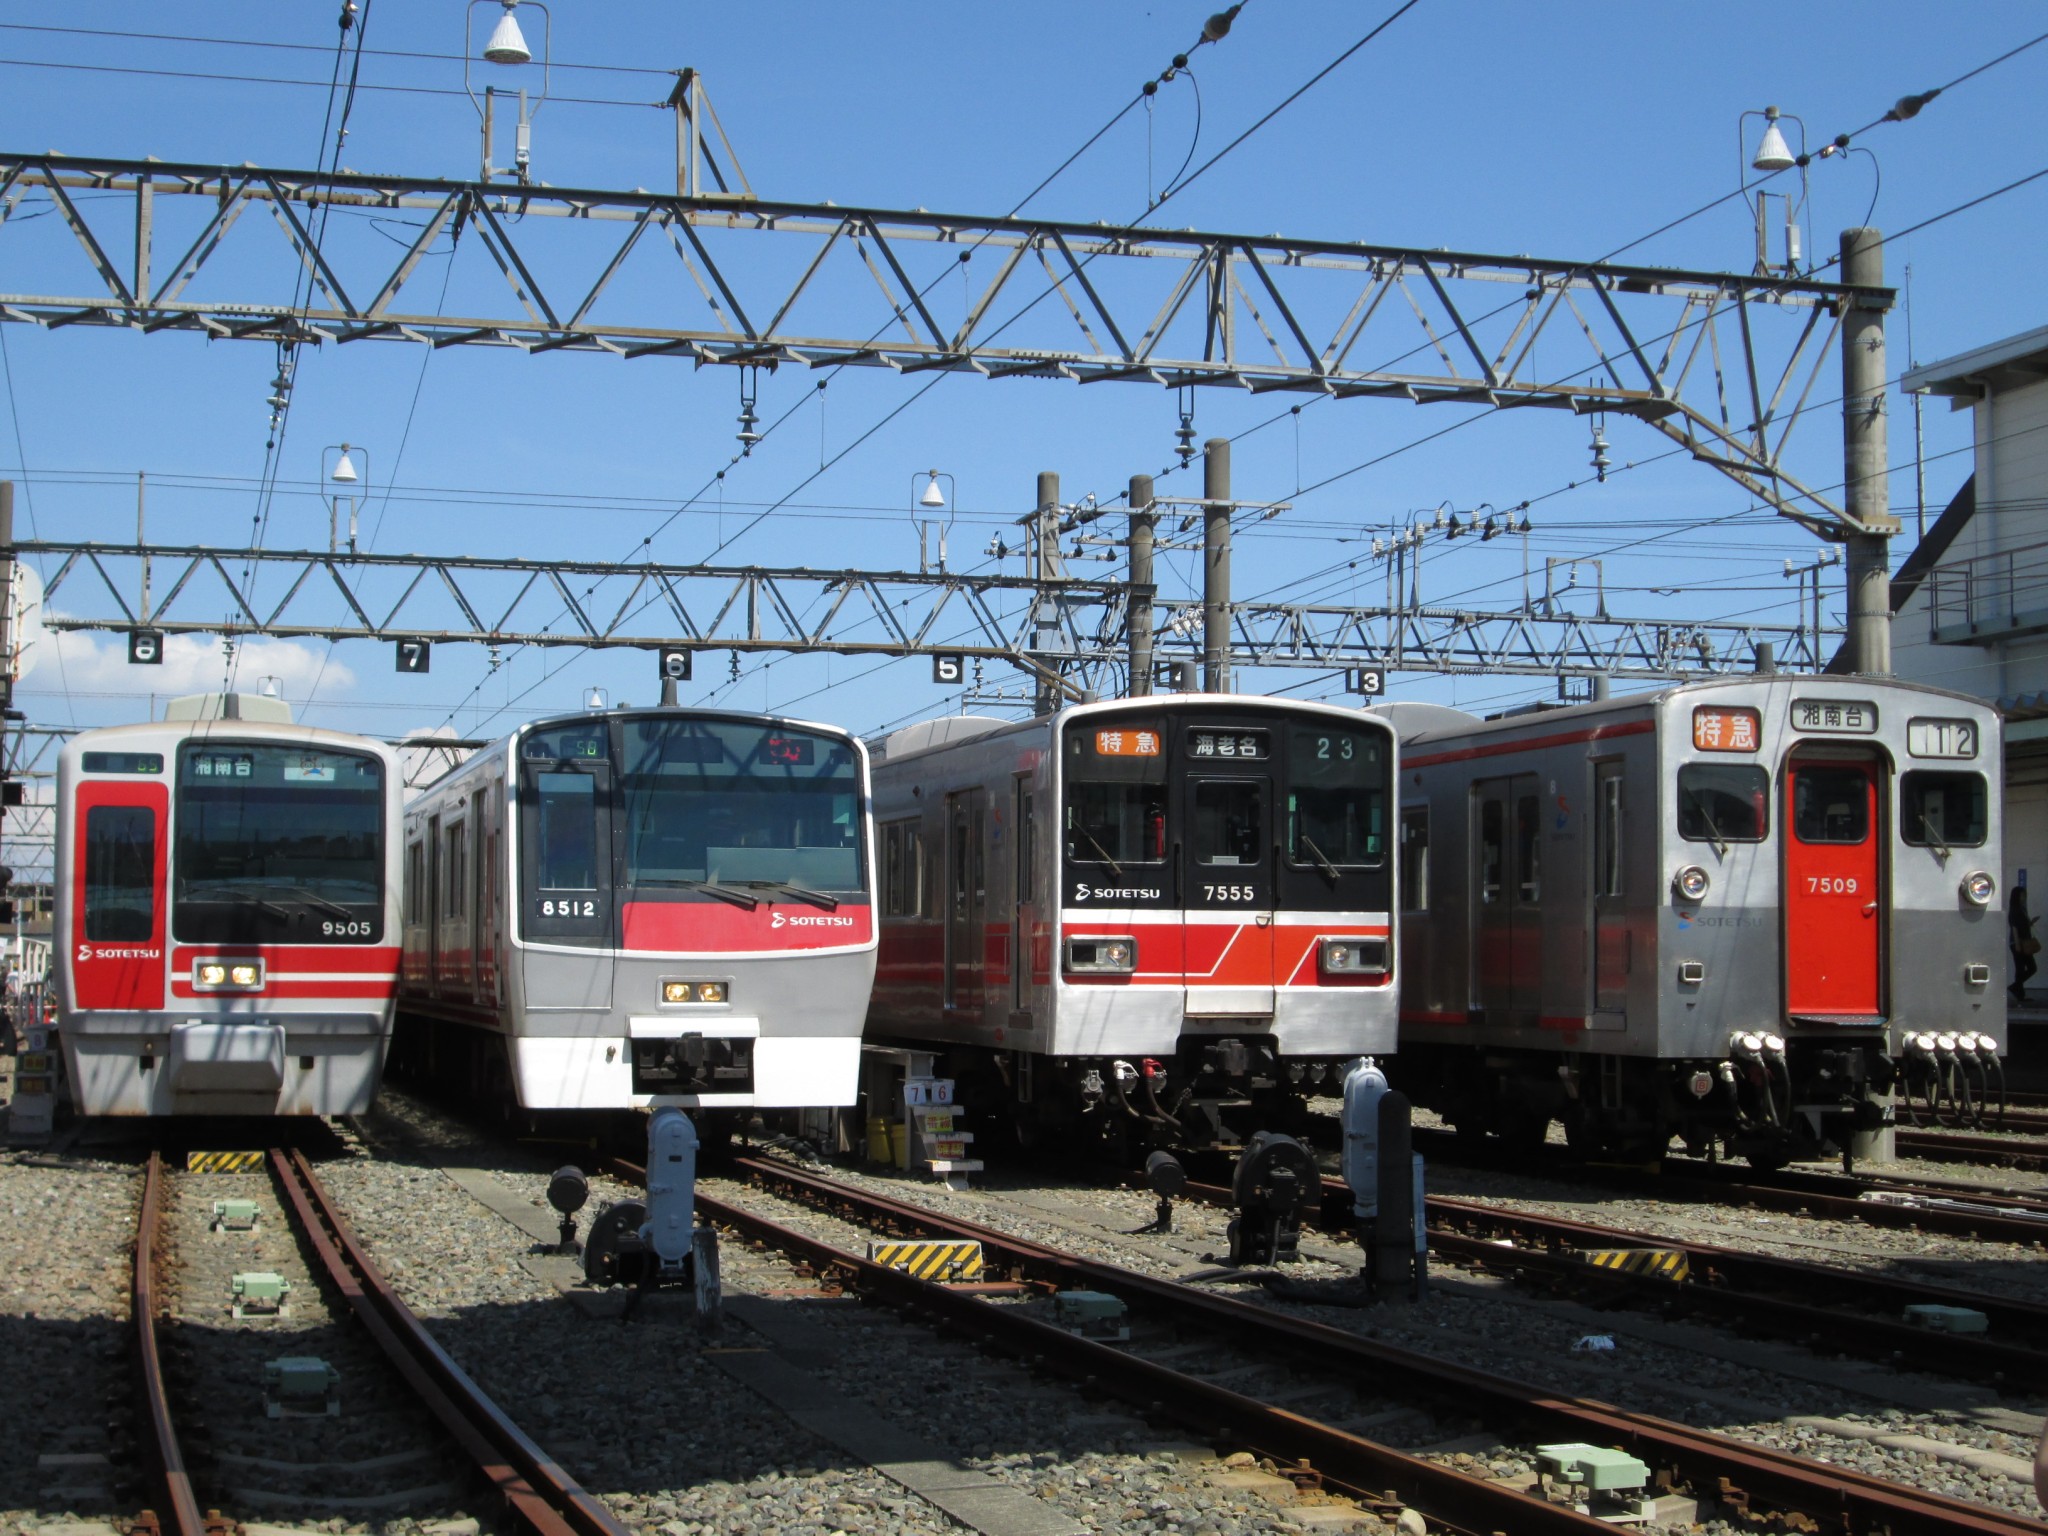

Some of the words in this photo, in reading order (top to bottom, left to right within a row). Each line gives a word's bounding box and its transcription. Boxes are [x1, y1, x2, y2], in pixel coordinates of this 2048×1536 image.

[135, 636, 156, 660] 8
[403, 643, 423, 668] 7
[665, 653, 686, 677] 6
[938, 657, 958, 680] 5
[1363, 671, 1381, 693] 3
[1803, 706, 1862, 727] 湘南台
[1696, 714, 1755, 748] 特急
[1101, 732, 1156, 753] 特急
[1196, 736, 1257, 756] 海老名
[1318, 739, 1353, 759] 23
[195, 757, 252, 777] 湘南台
[1094, 888, 1160, 899] SOTETSU
[1203, 886, 1254, 902] 7555
[1807, 878, 1858, 894] 7509
[542, 900, 594, 916] 8512
[322, 921, 371, 936] 9505
[789, 916, 853, 926] SOTETSU
[1697, 917, 1762, 927] SOTETSU
[95, 948, 160, 959] SOTETSU
[912, 1087, 919, 1101] 7
[938, 1085, 946, 1100] 6
